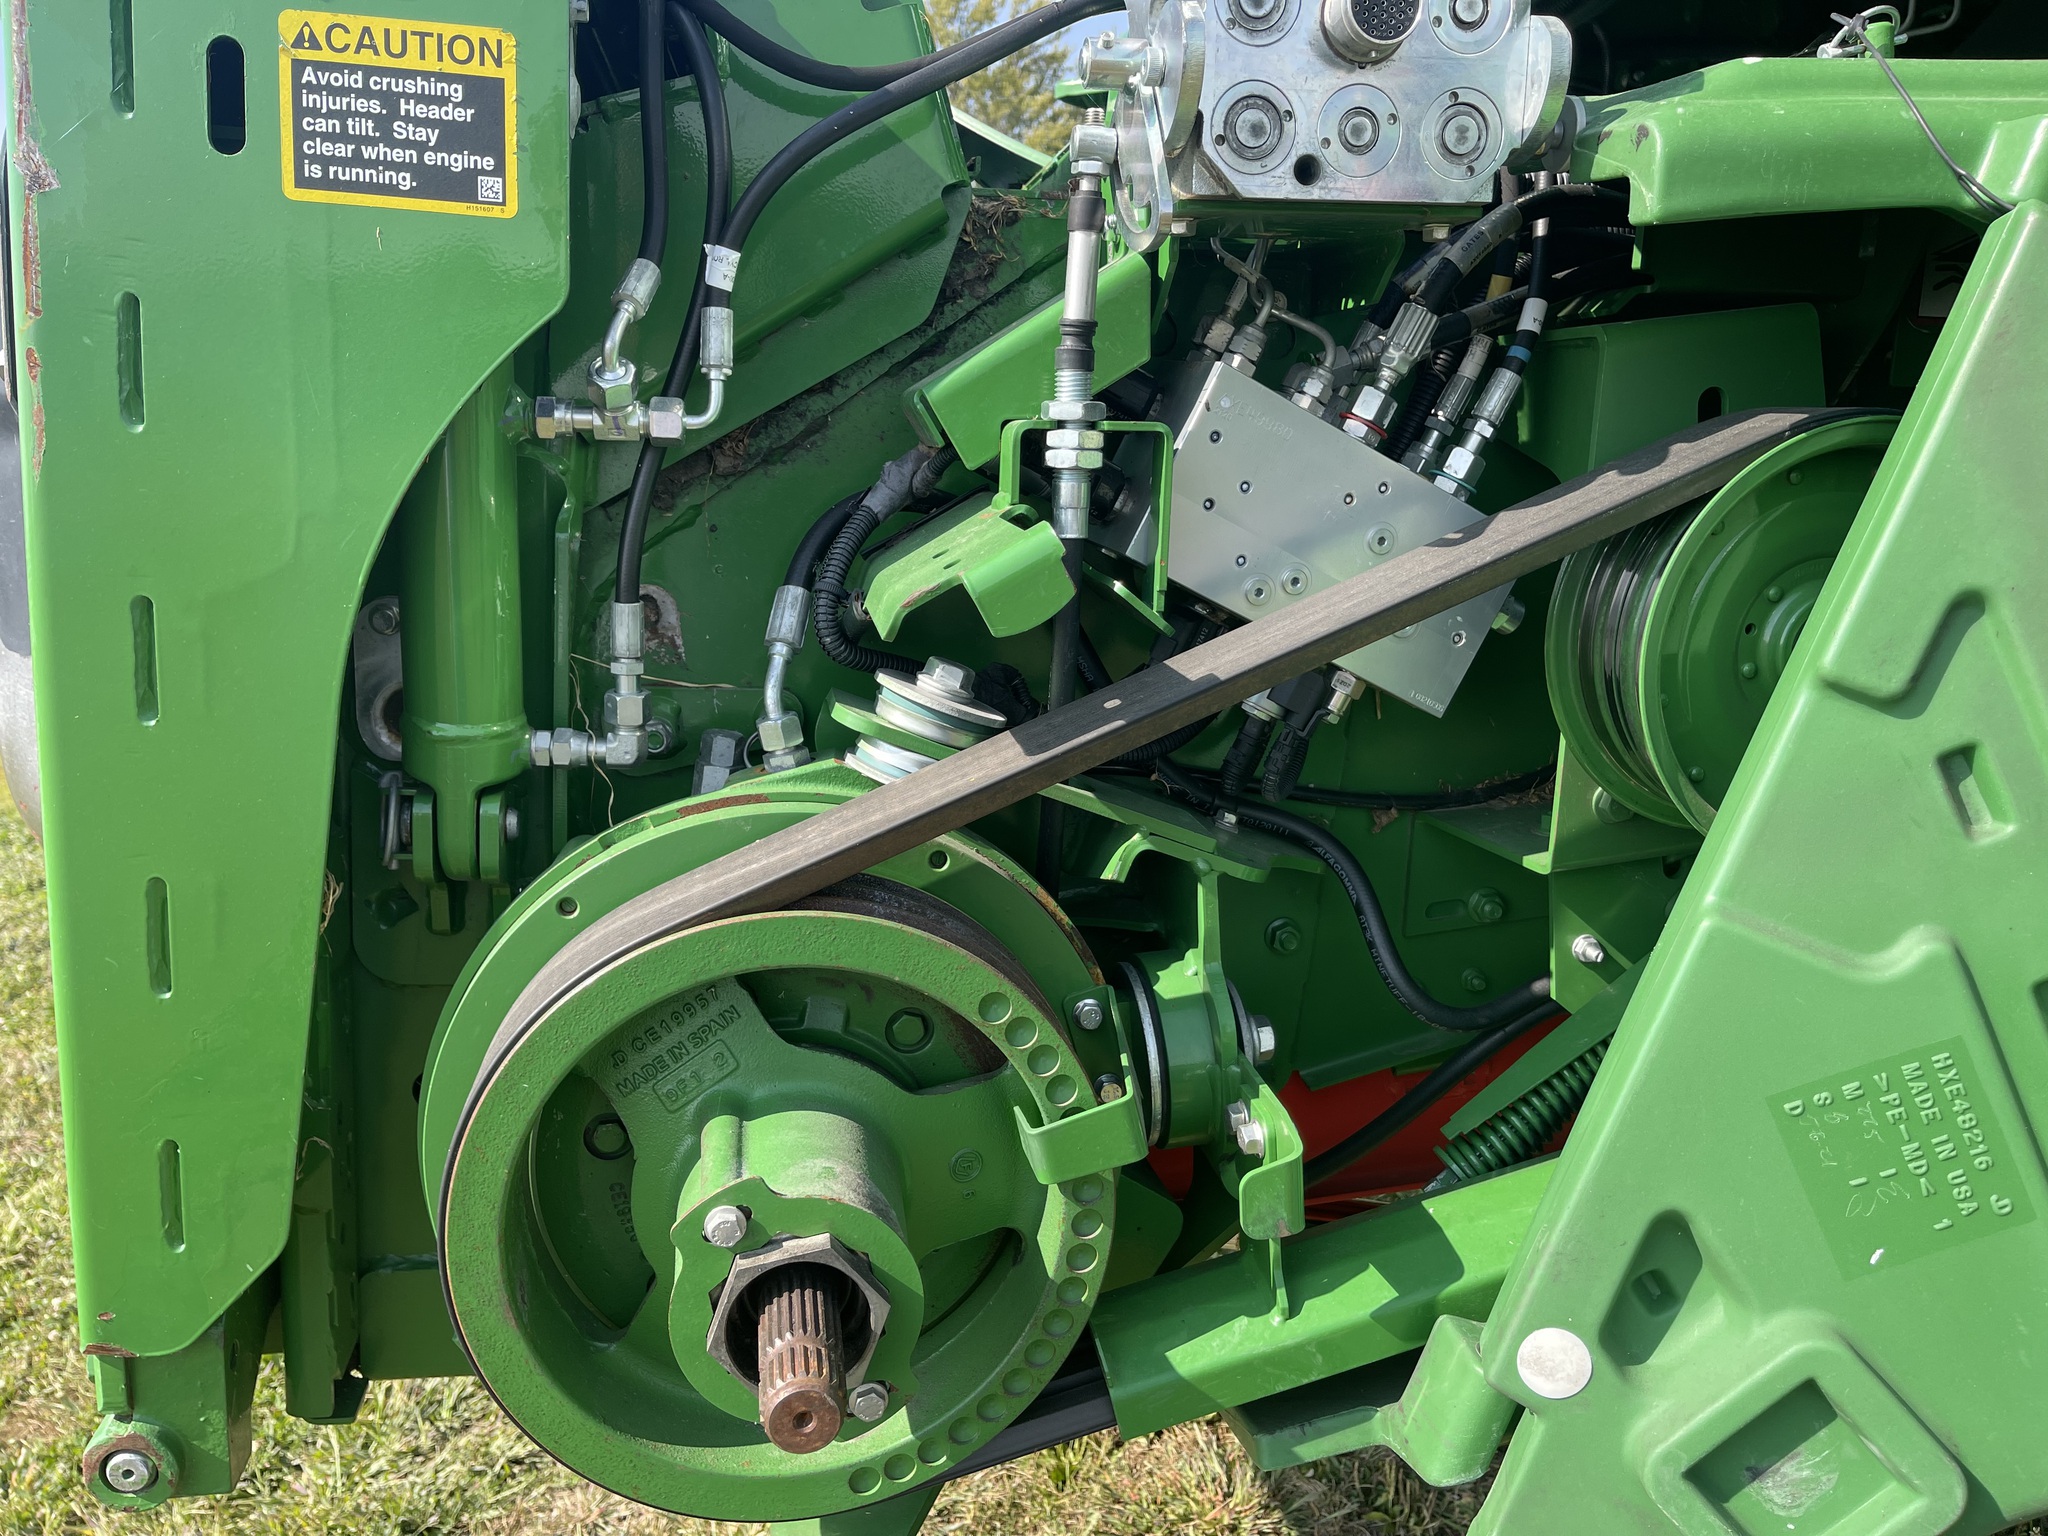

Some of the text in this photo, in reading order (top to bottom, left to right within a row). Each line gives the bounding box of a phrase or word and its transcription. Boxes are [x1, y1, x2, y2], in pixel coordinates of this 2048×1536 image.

[325, 22, 503, 68] CAUTION
[301, 66, 463, 102] Avoid crushing
[302, 90, 475, 122] injuries. Header
[302, 116, 439, 146] can tilt. Stay
[302, 138, 495, 172] clear when engine
[304, 160, 417, 191] is running.
[1461, 230, 1485, 252] GATES
[1312, 847, 1357, 906] ALFAGOMMA
[616, 1004, 741, 1098] MADE IN SPAIN
[1812, 1091, 1833, 1107] S
[1841, 1081, 1865, 1100] M
[1783, 1099, 1805, 1117] D
[1931, 1052, 1994, 1172] HXE48216
[1901, 1062, 1943, 1125] MADE
[1931, 1133, 1957, 1162] IN
[1947, 1168, 1980, 1217] USA
